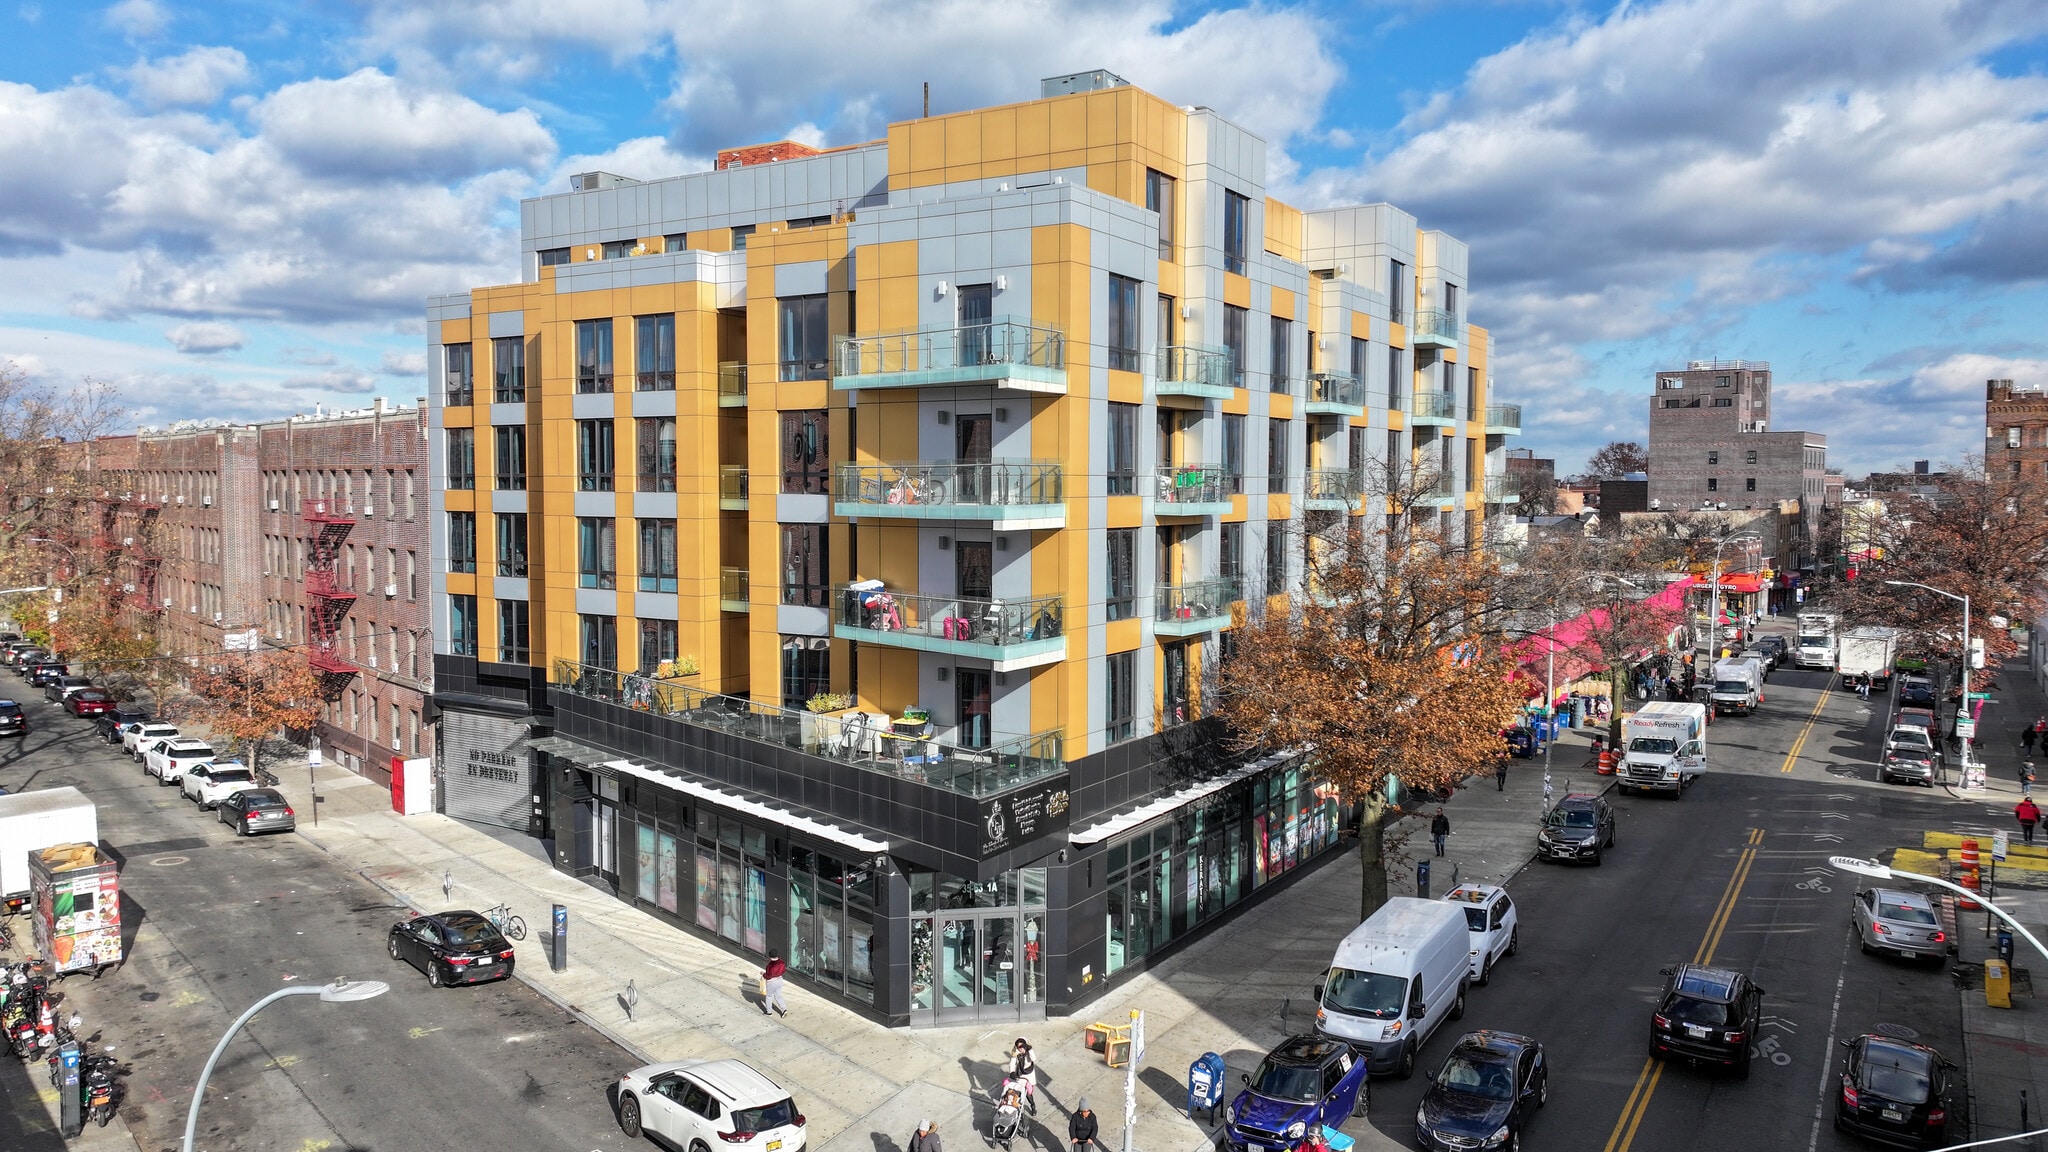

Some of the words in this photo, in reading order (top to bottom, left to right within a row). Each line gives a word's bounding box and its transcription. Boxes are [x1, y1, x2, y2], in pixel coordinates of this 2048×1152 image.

[1633, 719, 1680, 729] ReadyRefresh
[469, 748, 479, 761] NO
[481, 750, 517, 767] PARKING
[467, 763, 477, 776] IN
[479, 765, 519, 783] DRIVEWAY
[986, 881, 998, 893] 1A
